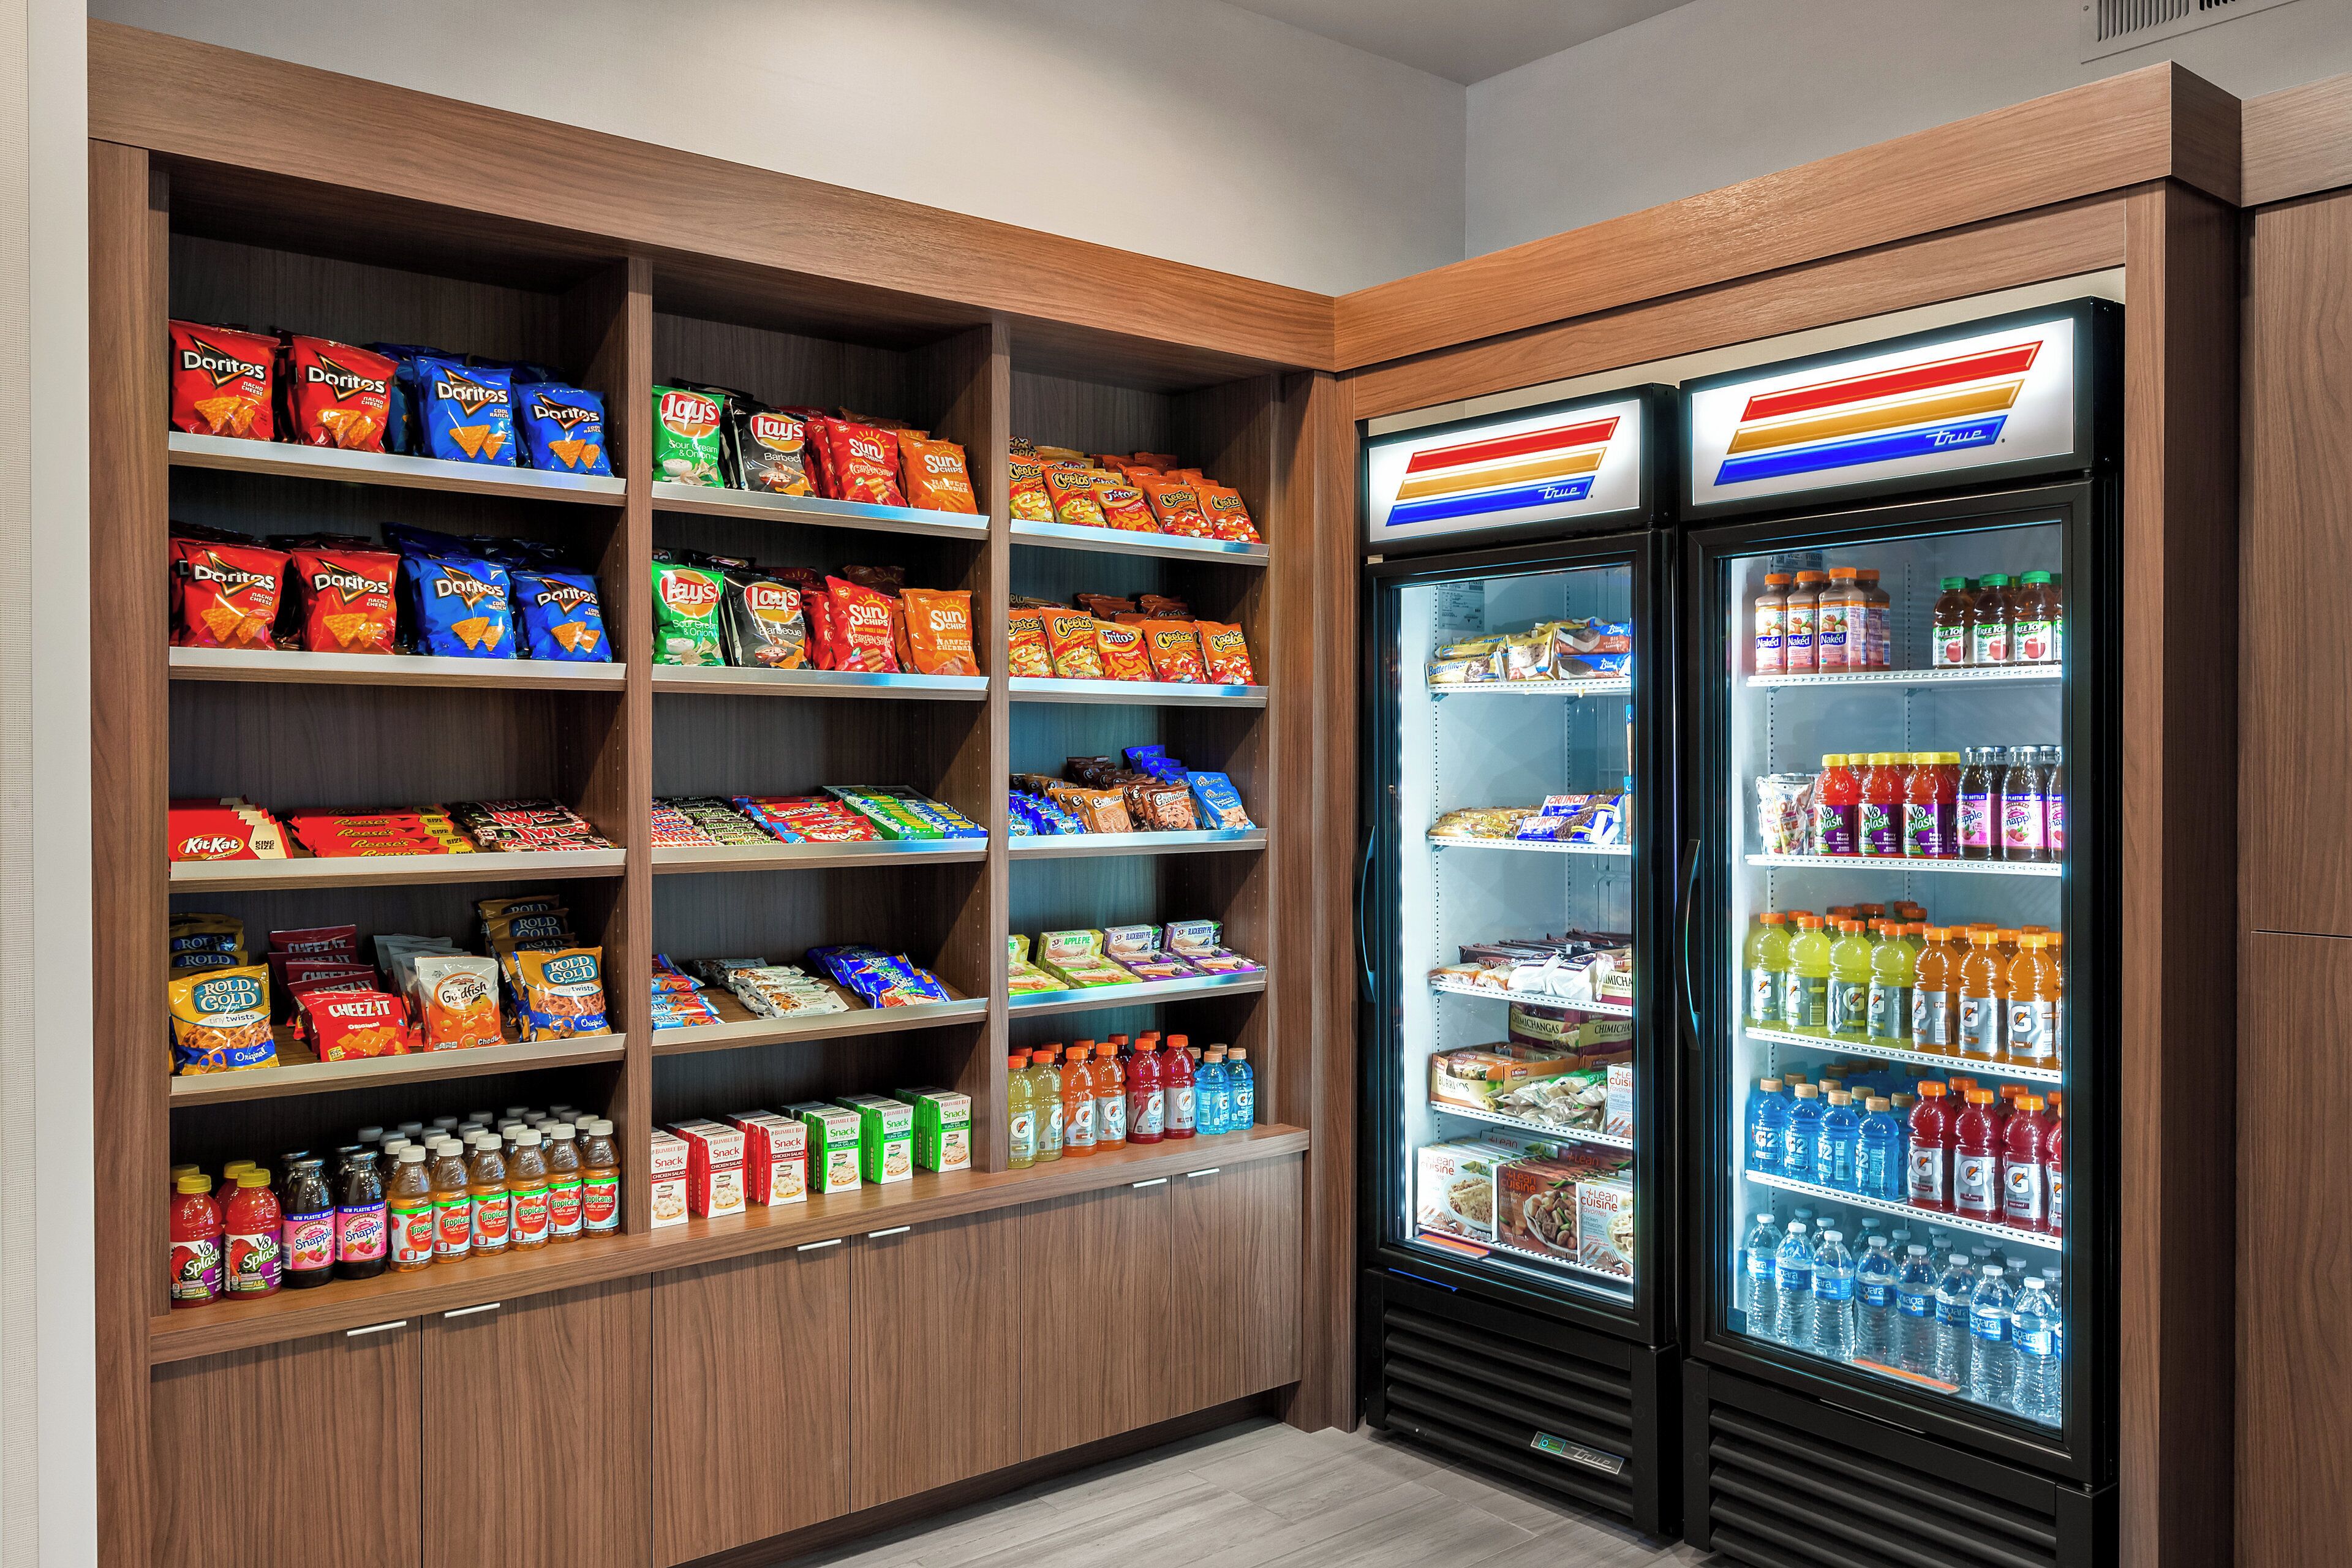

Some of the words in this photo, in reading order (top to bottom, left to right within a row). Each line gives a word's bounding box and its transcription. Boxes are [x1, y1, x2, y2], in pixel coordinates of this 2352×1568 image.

[184, 350, 266, 379] Doritos
[309, 366, 385, 393] Doritos
[241, 385, 263, 397] CHEESE
[243, 381, 263, 392] NACHO
[437, 382, 508, 403] Doritos
[361, 400, 383, 409] CHEESE
[363, 396, 384, 405] NACHO
[533, 405, 600, 423] Doritos
[665, 394, 716, 424] Lay's
[757, 417, 804, 441] Lay's
[669, 440, 689, 450] Sour
[693, 443, 718, 453] Cream
[848, 438, 885, 461] Sun
[685, 449, 712, 459] Onion
[924, 454, 963, 474] Sun
[1054, 472, 1091, 489] Cheetos
[195, 564, 275, 590] Doritos
[315, 573, 389, 594] Doritos
[436, 579, 504, 598] Doritos
[667, 580, 715, 604] Lay's
[249, 596, 273, 606] CHEESE
[252, 592, 273, 601] NACHO
[538, 588, 598, 606] Doritos
[752, 587, 799, 611] Lay's
[366, 601, 388, 610] CHEESE
[849, 604, 889, 625] Sun
[930, 609, 967, 631] Sun
[863, 618, 888, 627] CHIPS
[1054, 616, 1093, 638] Cheetos
[760, 627, 802, 637] Barbecue
[1101, 629, 1135, 644] Fritos
[1821, 633, 1844, 644] Naked
[1156, 631, 1193, 649] Cheetos
[1212, 632, 1245, 652] Cheetos
[1788, 635, 1810, 646] Naked
[1429, 659, 1468, 677] Butterfinger
[1548, 795, 1587, 805] CRUNCH
[1822, 806, 1832, 818] V8
[1868, 805, 1879, 816] V8
[1912, 805, 1924, 818] V8
[1525, 817, 1561, 827] CRUNCH
[337, 829, 396, 837] Reese's
[350, 840, 410, 848] Reese's
[518, 917, 557, 929] ROLD
[1082, 936, 1091, 944] PIE
[1126, 932, 1146, 940] BLACKBERRY
[186, 954, 230, 965] ROLD
[549, 956, 590, 972] ROLD
[549, 965, 595, 983] GOLD
[204, 979, 251, 995] ROLD
[201, 992, 258, 1012] GOLD
[226, 1013, 255, 1022] twists
[1512, 1013, 1559, 1034] CHIMICHANGAS
[1594, 1022, 1632, 1035] CHIMICHAN
[235, 1044, 268, 1061] Original
[943, 1109, 967, 1119] Snack
[886, 1118, 909, 1128] Snack
[830, 1127, 856, 1137] Snack
[774, 1137, 801, 1148] Snack
[655, 1147, 676, 1155] BUMBLE
[713, 1148, 740, 1158] Snack
[655, 1156, 683, 1168] Snack
[552, 1198, 580, 1209] Tropicana
[584, 1194, 612, 1203] Tropicana
[481, 1209, 508, 1221] Tropicana
[518, 1205, 547, 1217] Tropicana
[1580, 1206, 1607, 1218] favorites
[345, 1221, 383, 1242] Snapple
[256, 1234, 270, 1250] V8
[295, 1227, 333, 1250] Snapple
[198, 1240, 211, 1256] V8
[185, 1248, 221, 1277] Splash
[243, 1242, 280, 1270] Splash
